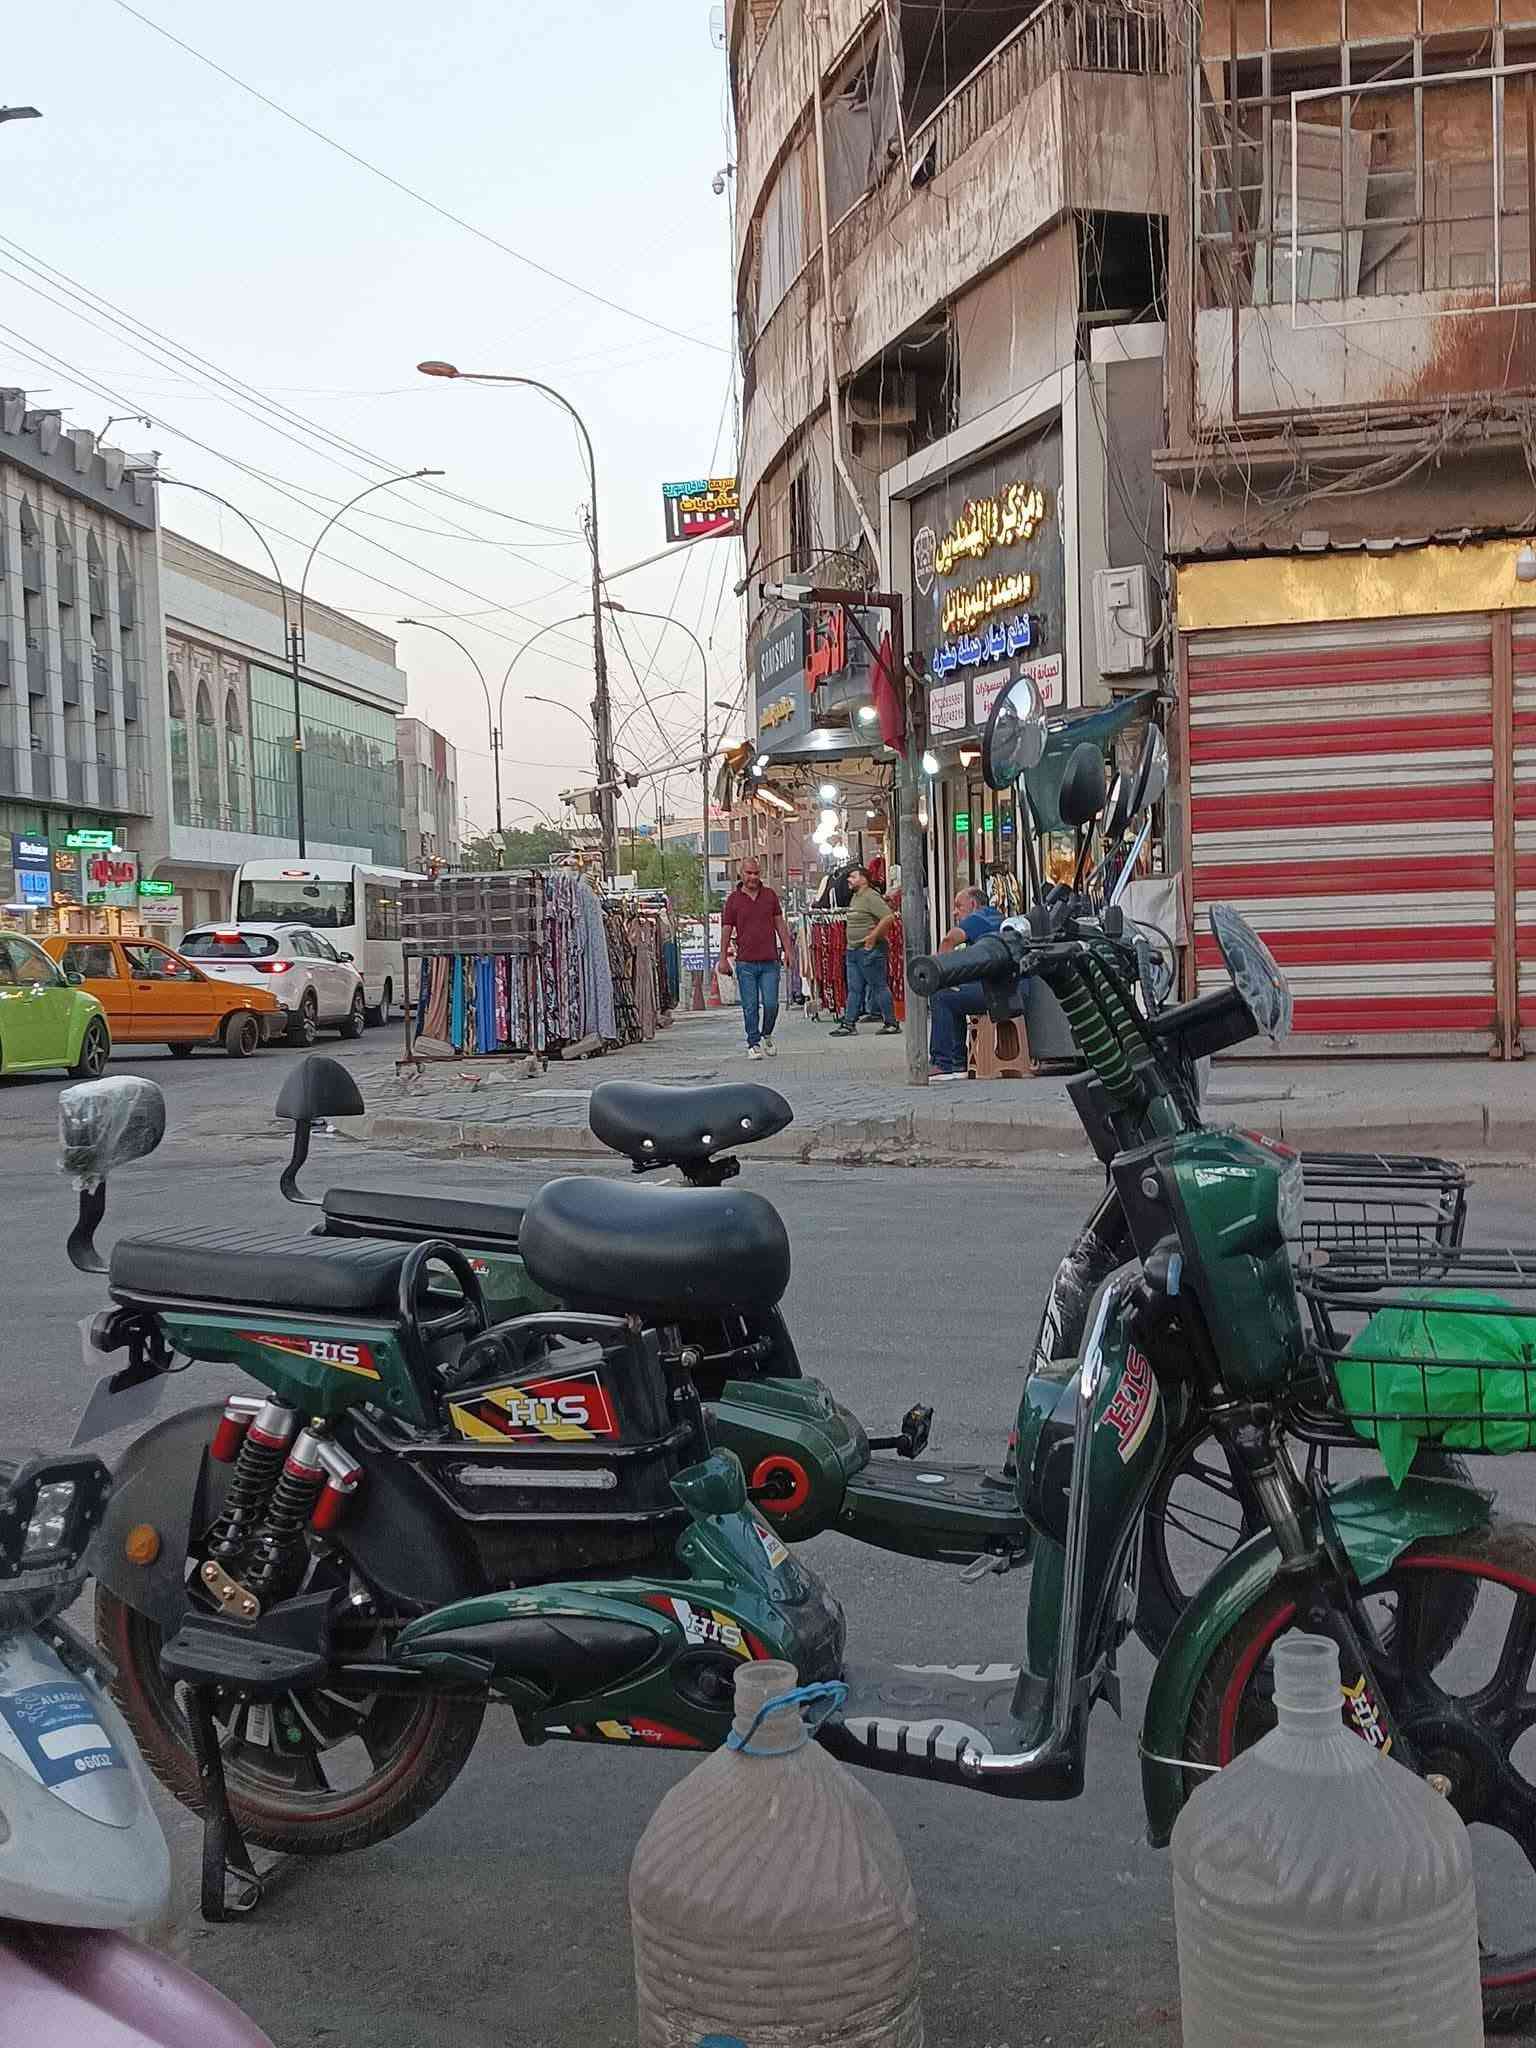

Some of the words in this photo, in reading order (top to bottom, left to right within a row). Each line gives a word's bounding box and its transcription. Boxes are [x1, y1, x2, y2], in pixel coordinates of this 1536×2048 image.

[997, 482, 1044, 545] مركز
[957, 633, 982, 667] جملة
[982, 622, 1007, 661] غيار
[1006, 612, 1031, 658] قطع
[760, 631, 796, 683] SAMSUNG
[309, 1341, 360, 1366] HIS
[506, 1395, 590, 1427] HIS
[1099, 1344, 1152, 1439] HIS
[686, 1614, 743, 1649] HIS
